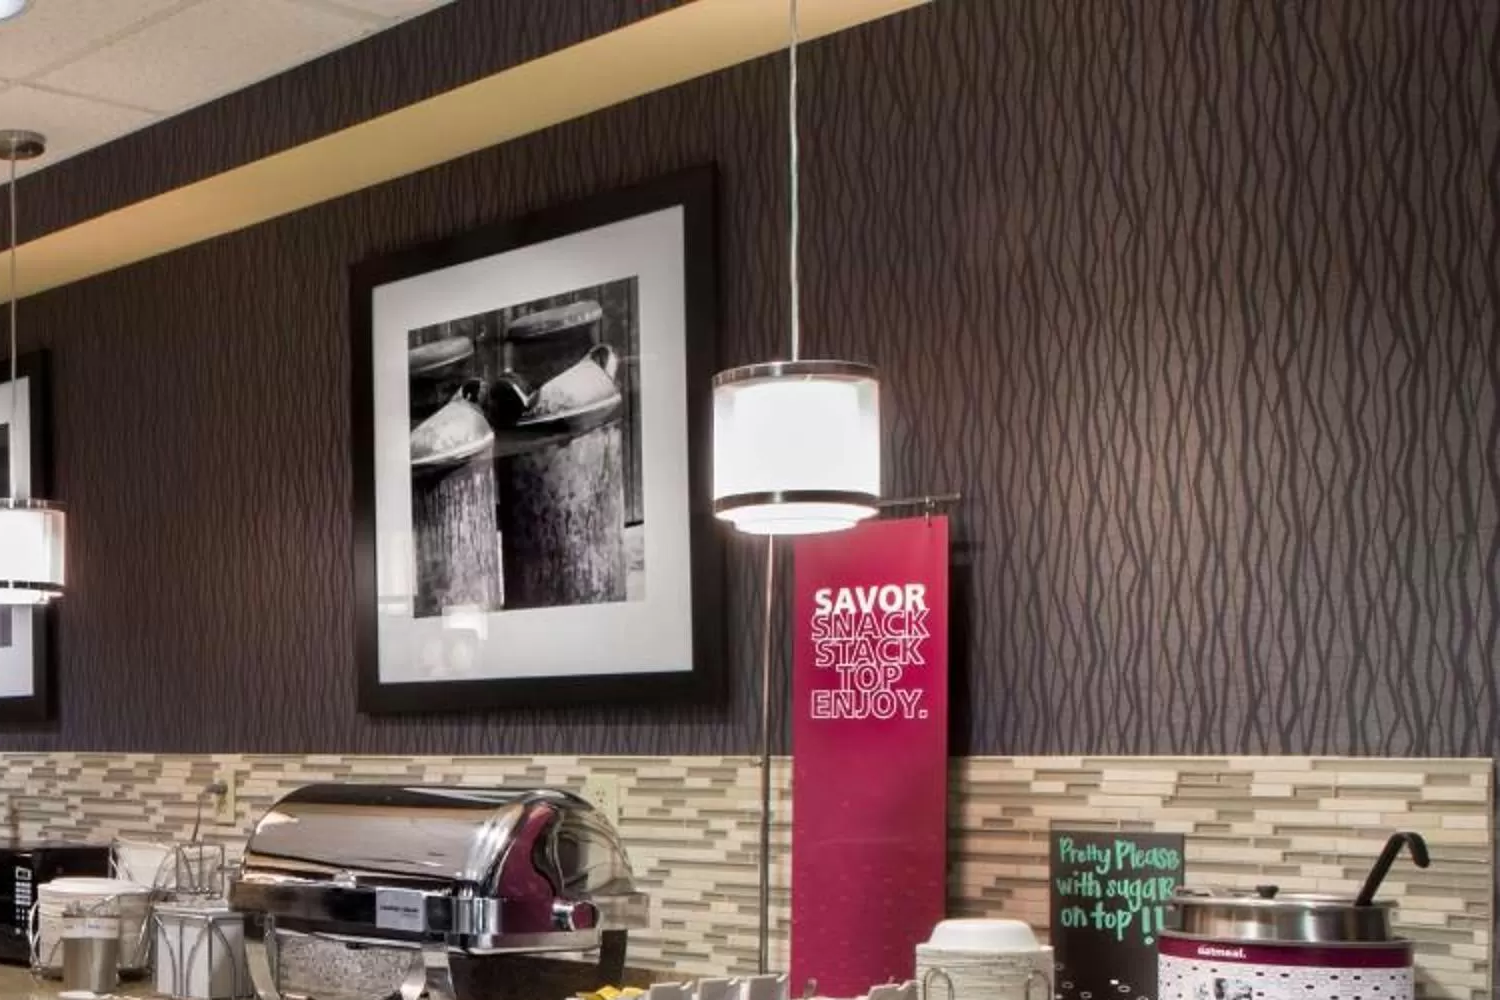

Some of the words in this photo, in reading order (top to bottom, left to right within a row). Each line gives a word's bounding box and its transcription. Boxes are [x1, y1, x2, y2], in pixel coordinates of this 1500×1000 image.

[815, 583, 927, 616] SAVOR
[811, 607, 930, 641] SNACK
[815, 637, 926, 667] STACK
[835, 660, 902, 693] TOP
[811, 688, 929, 719] ENJOY.
[1060, 837, 1111, 875] Pretty
[1114, 839, 1180, 870] Please
[1056, 870, 1102, 898] with
[1061, 905, 1088, 928] on
